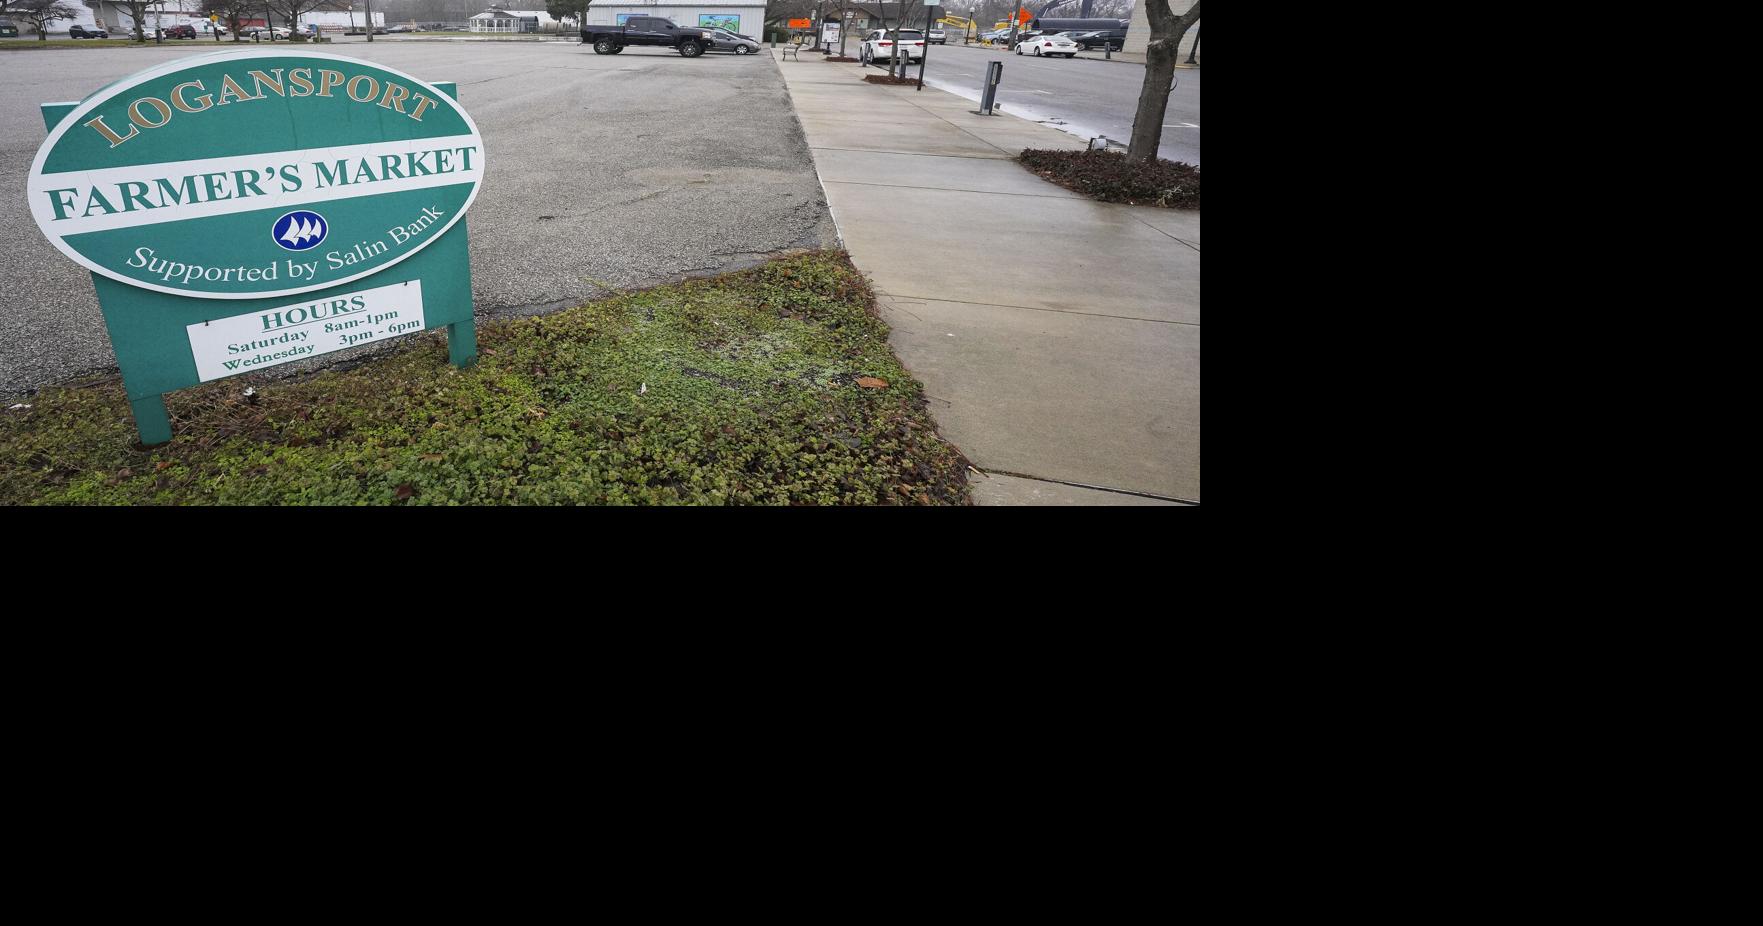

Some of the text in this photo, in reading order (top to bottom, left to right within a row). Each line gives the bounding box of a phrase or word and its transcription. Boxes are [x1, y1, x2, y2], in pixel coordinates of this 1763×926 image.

[84, 67, 439, 148] LOGANSPORT
[44, 146, 477, 221] FARMER'S MARKET
[126, 203, 445, 284] Supported by Salin Bank
[227, 309, 399, 356] Saturday 8am-1pm
[260, 295, 366, 330] HOURS
[222, 343, 315, 372] Wednesday
[339, 330, 374, 347] 3pm
[388, 319, 421, 335] 6pm
